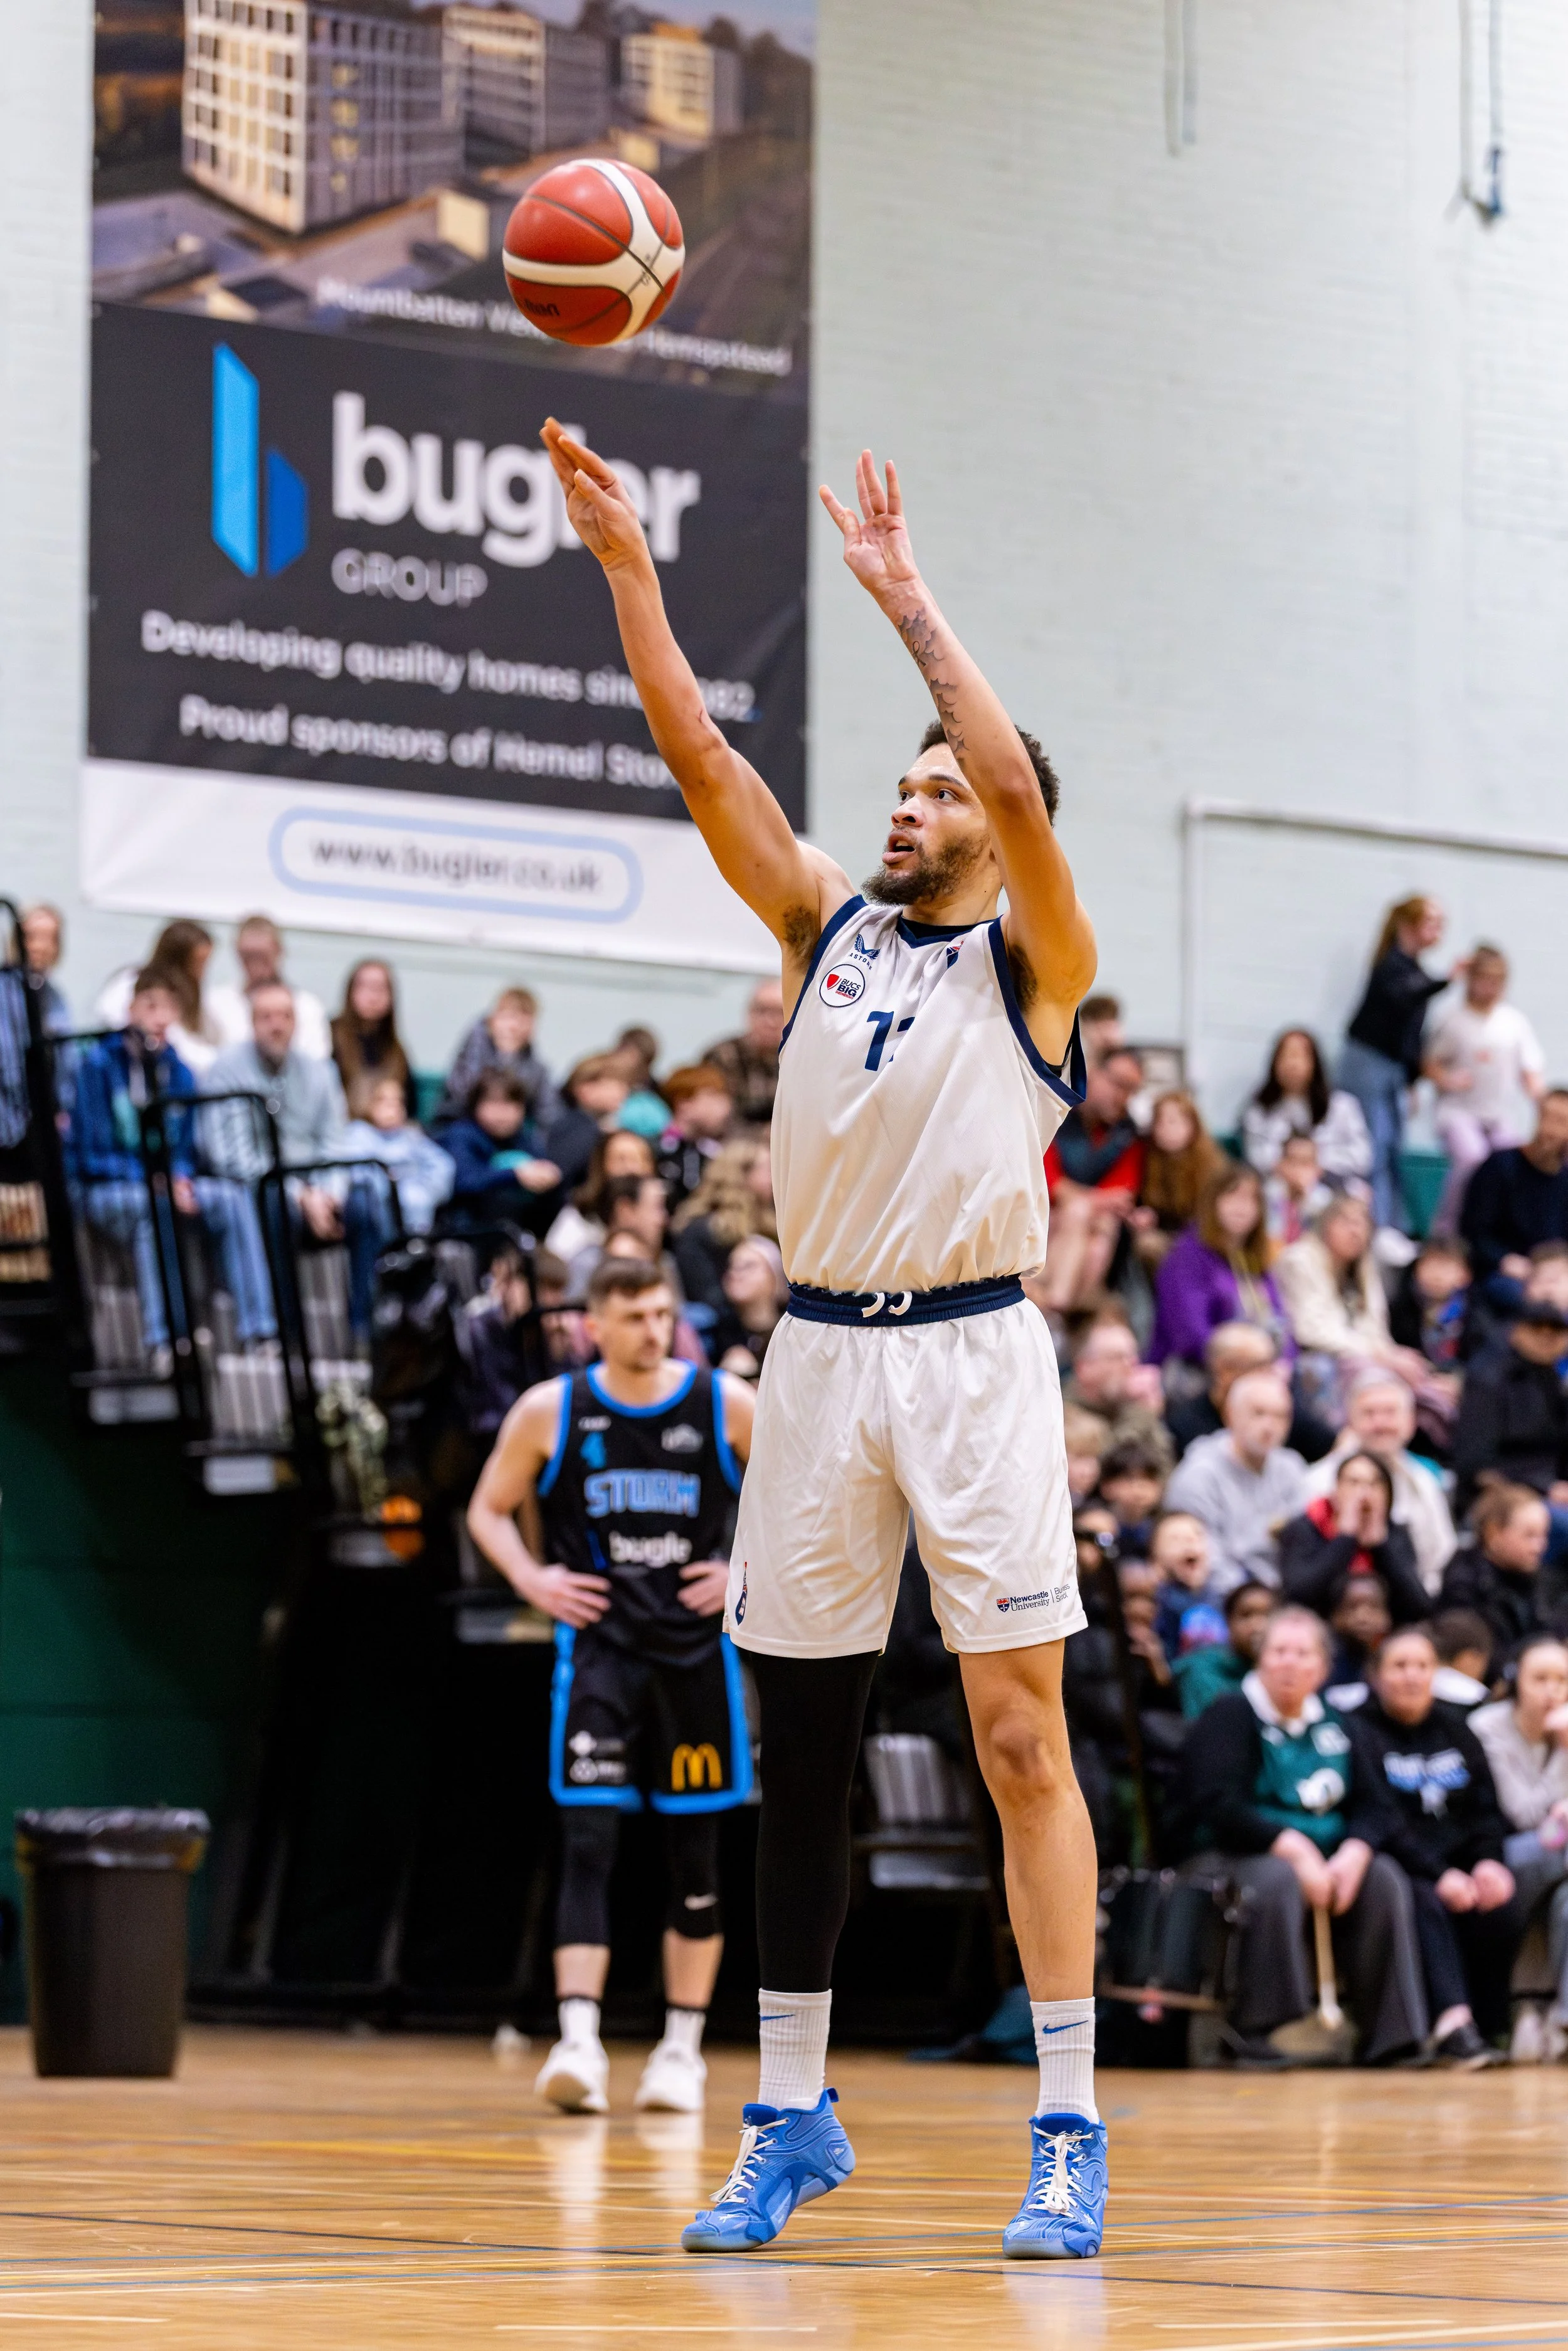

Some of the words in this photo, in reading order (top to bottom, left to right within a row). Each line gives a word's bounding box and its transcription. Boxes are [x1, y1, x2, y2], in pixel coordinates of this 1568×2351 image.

[331, 548, 488, 607] GROUP
[141, 609, 342, 679] Developing
[344, 642, 465, 694] quality
[467, 649, 583, 703] homes
[179, 694, 289, 746] Proud
[290, 714, 447, 764] sponsors
[449, 726, 492, 769] of
[493, 730, 604, 782] Hemel
[310, 839, 605, 894] www.bugler.co.uk
[837, 984, 857, 997] BIG
[840, 979, 861, 990] BUCS
[583, 1468, 701, 1519] STORM
[608, 1531, 693, 1568] bugle
[1010, 1590, 1049, 1605] Newcastle
[1010, 1599, 1049, 1611] University
